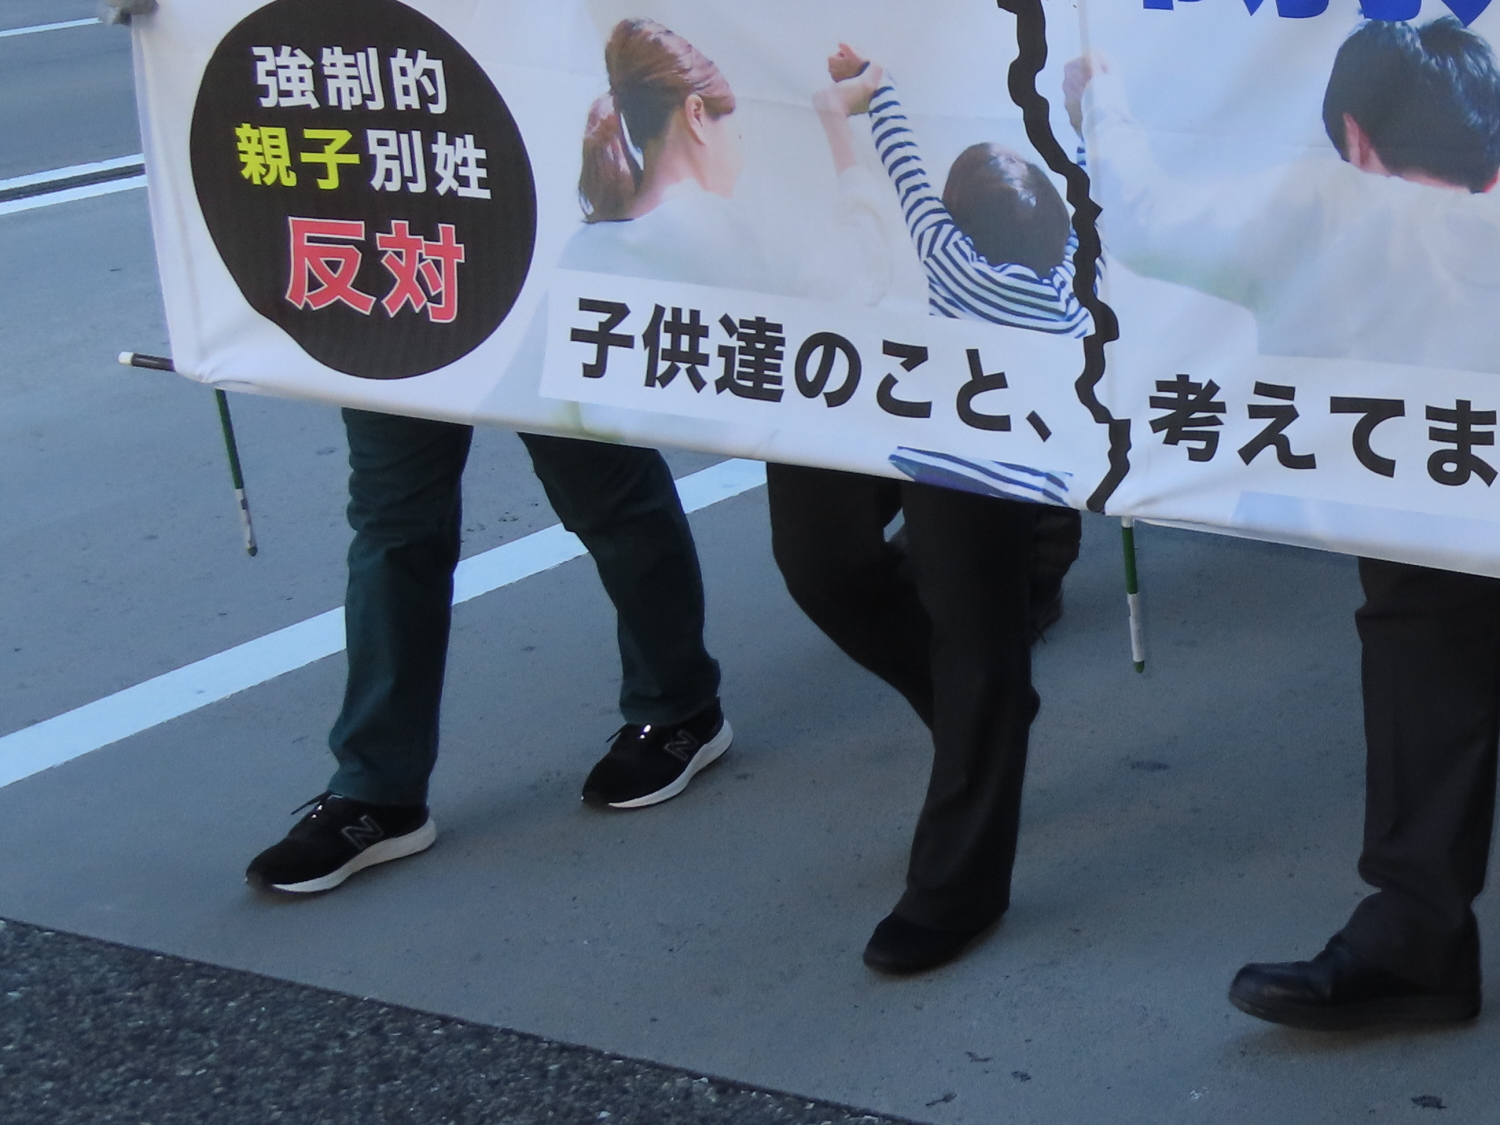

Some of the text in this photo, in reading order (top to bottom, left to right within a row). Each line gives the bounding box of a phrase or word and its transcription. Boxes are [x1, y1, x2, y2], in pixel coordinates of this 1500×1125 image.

[251, 45, 449, 116] 強制的
[235, 122, 492, 201] 親子別姓
[284, 216, 467, 324] 反対
